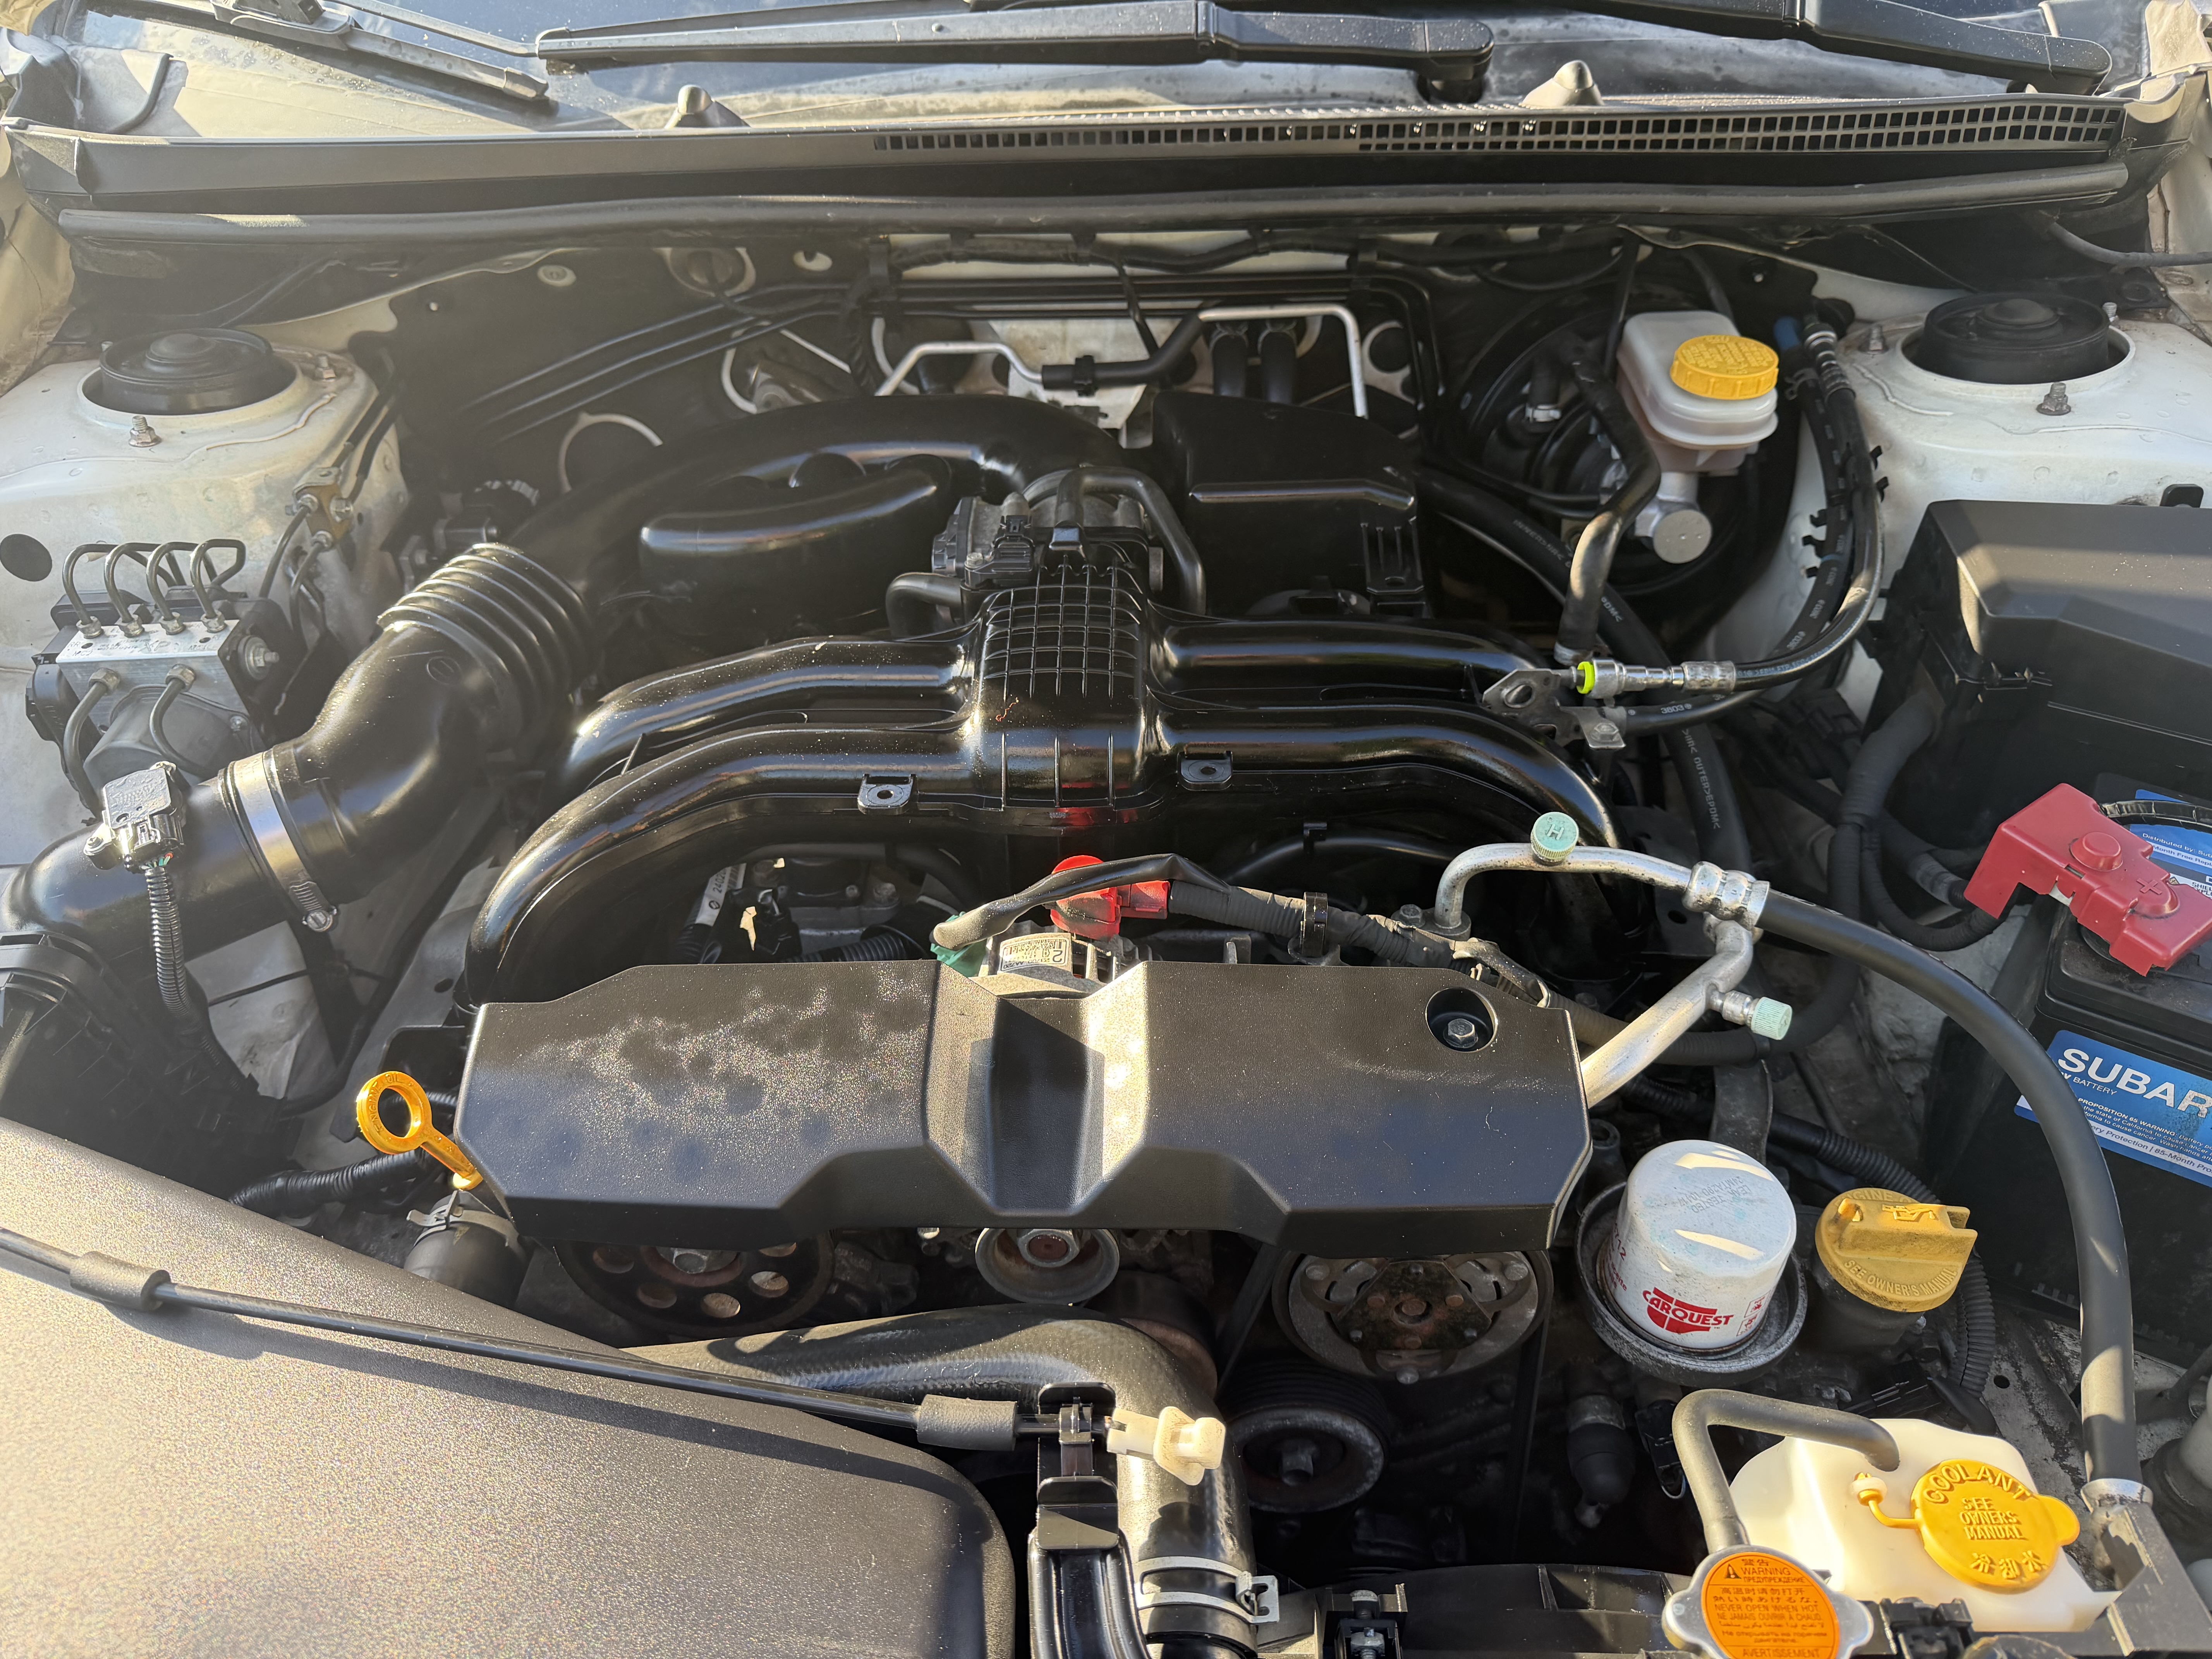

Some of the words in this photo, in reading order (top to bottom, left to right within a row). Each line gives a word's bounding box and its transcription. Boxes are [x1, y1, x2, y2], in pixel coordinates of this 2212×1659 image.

[1547, 824, 1565, 840] H
[2142, 833, 2182, 849] Distributed
[2153, 845, 2175, 855] Month
[2177, 852, 2193, 860] Free
[2195, 858, 2212, 867] Repl
[1053, 950, 1063, 962] 2
[2073, 1077, 2117, 1096] BATTERY
[2078, 1098, 2128, 1119] PROPOSITION
[2140, 1120, 2177, 1137] WARNING:
[2179, 1134, 2203, 1147] Battery
[2095, 1109, 2112, 1119] state
[2122, 1120, 2152, 1134] California
[2163, 1135, 2184, 1145] cause
[2106, 1130, 2148, 1150] Protection
[2154, 1148, 2195, 1167] 85-Month
[2112, 1122, 2132, 1132] cause
[2160, 1139, 2178, 1149] Wash
[2180, 1147, 2200, 1157] hands
[1844, 1260, 1867, 1279] SEE
[1867, 1275, 1919, 1297] OWNER'S
[1920, 1268, 1958, 1295] MANUAL
[1643, 1290, 1734, 1326] CARQUEST
[1923, 1463, 2031, 1503] COOLANT
[1961, 1497, 1994, 1510] SEE
[1959, 1511, 2018, 1525] OWNERS
[1964, 1525, 2023, 1540] MANUAL
[1740, 1567, 1791, 1575] WARNING
[1743, 1649, 1820, 1658] AVERTISSEMENT
